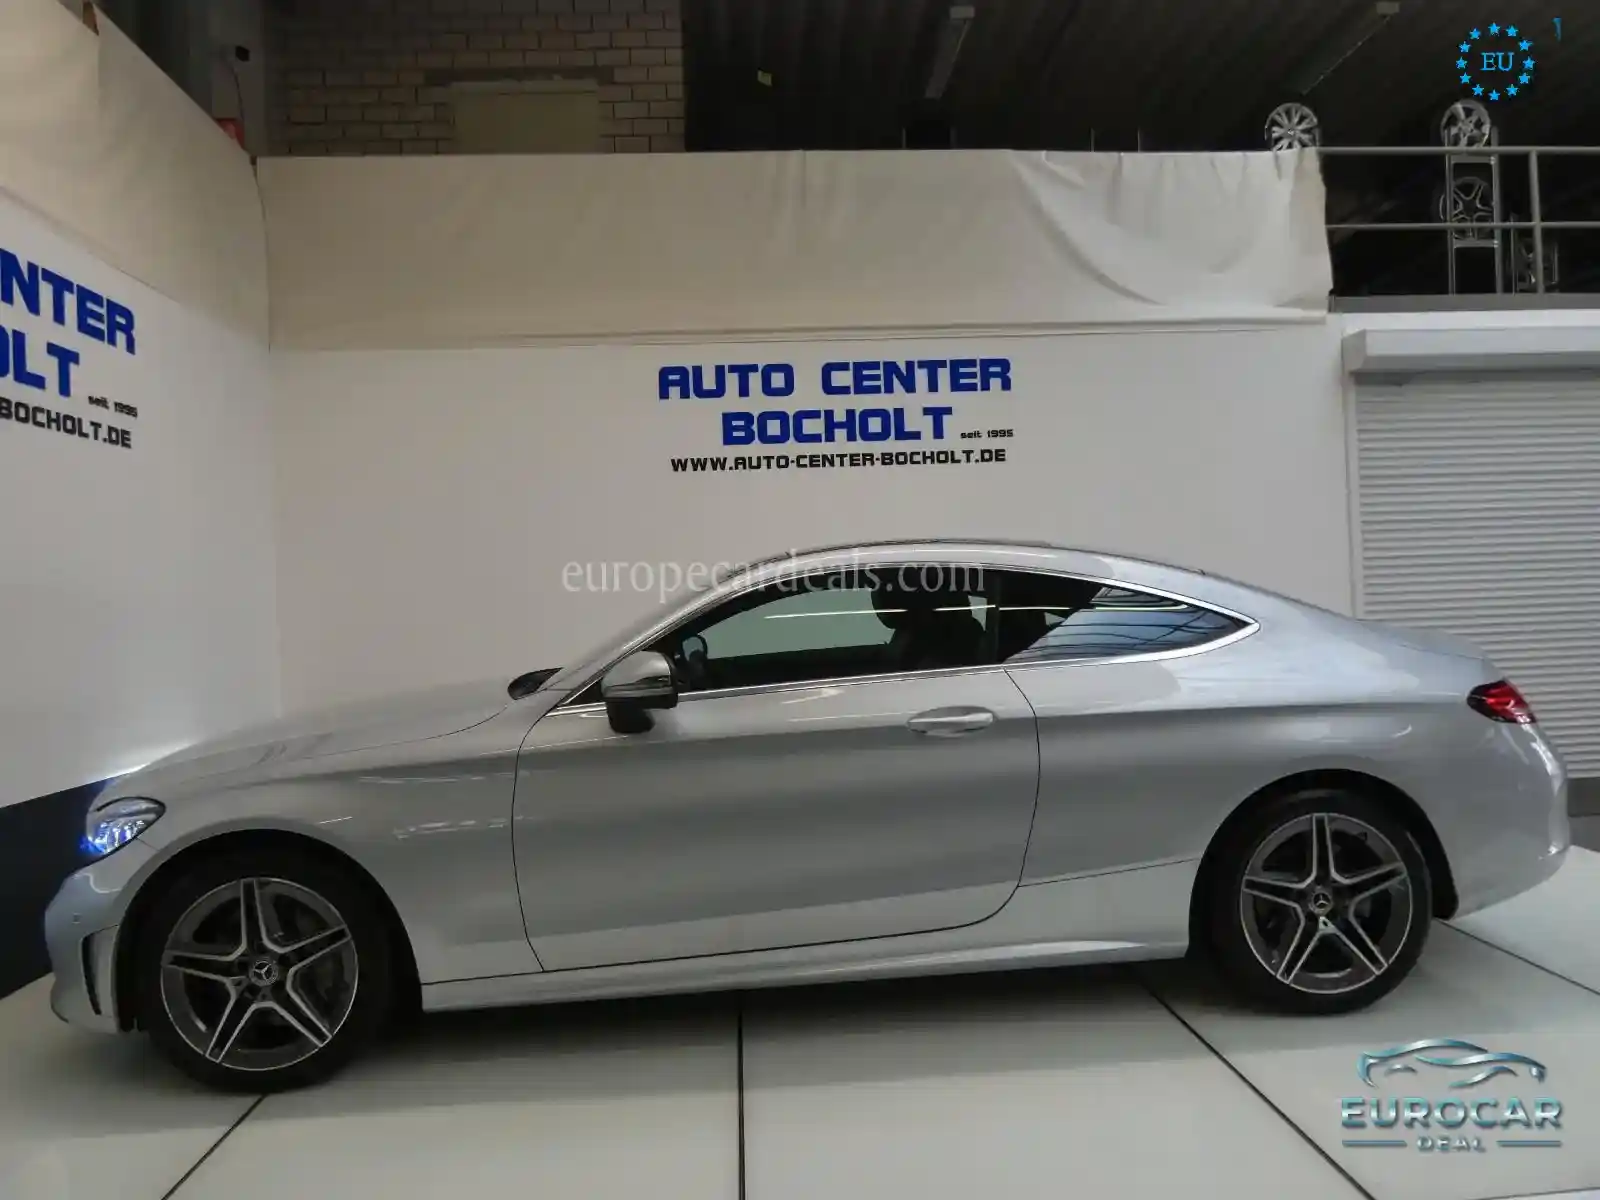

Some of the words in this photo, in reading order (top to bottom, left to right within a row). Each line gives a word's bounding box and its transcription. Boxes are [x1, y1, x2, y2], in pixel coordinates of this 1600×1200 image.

[658, 363, 795, 400] AUTO
[821, 357, 1012, 396] CENTER
[721, 406, 953, 446] BOCHOLT
[960, 430, 982, 439] seit
[987, 428, 1014, 438] 1995
[670, 448, 1006, 472] WWW.AUTO-CENTER-BOCHOLT.DE
